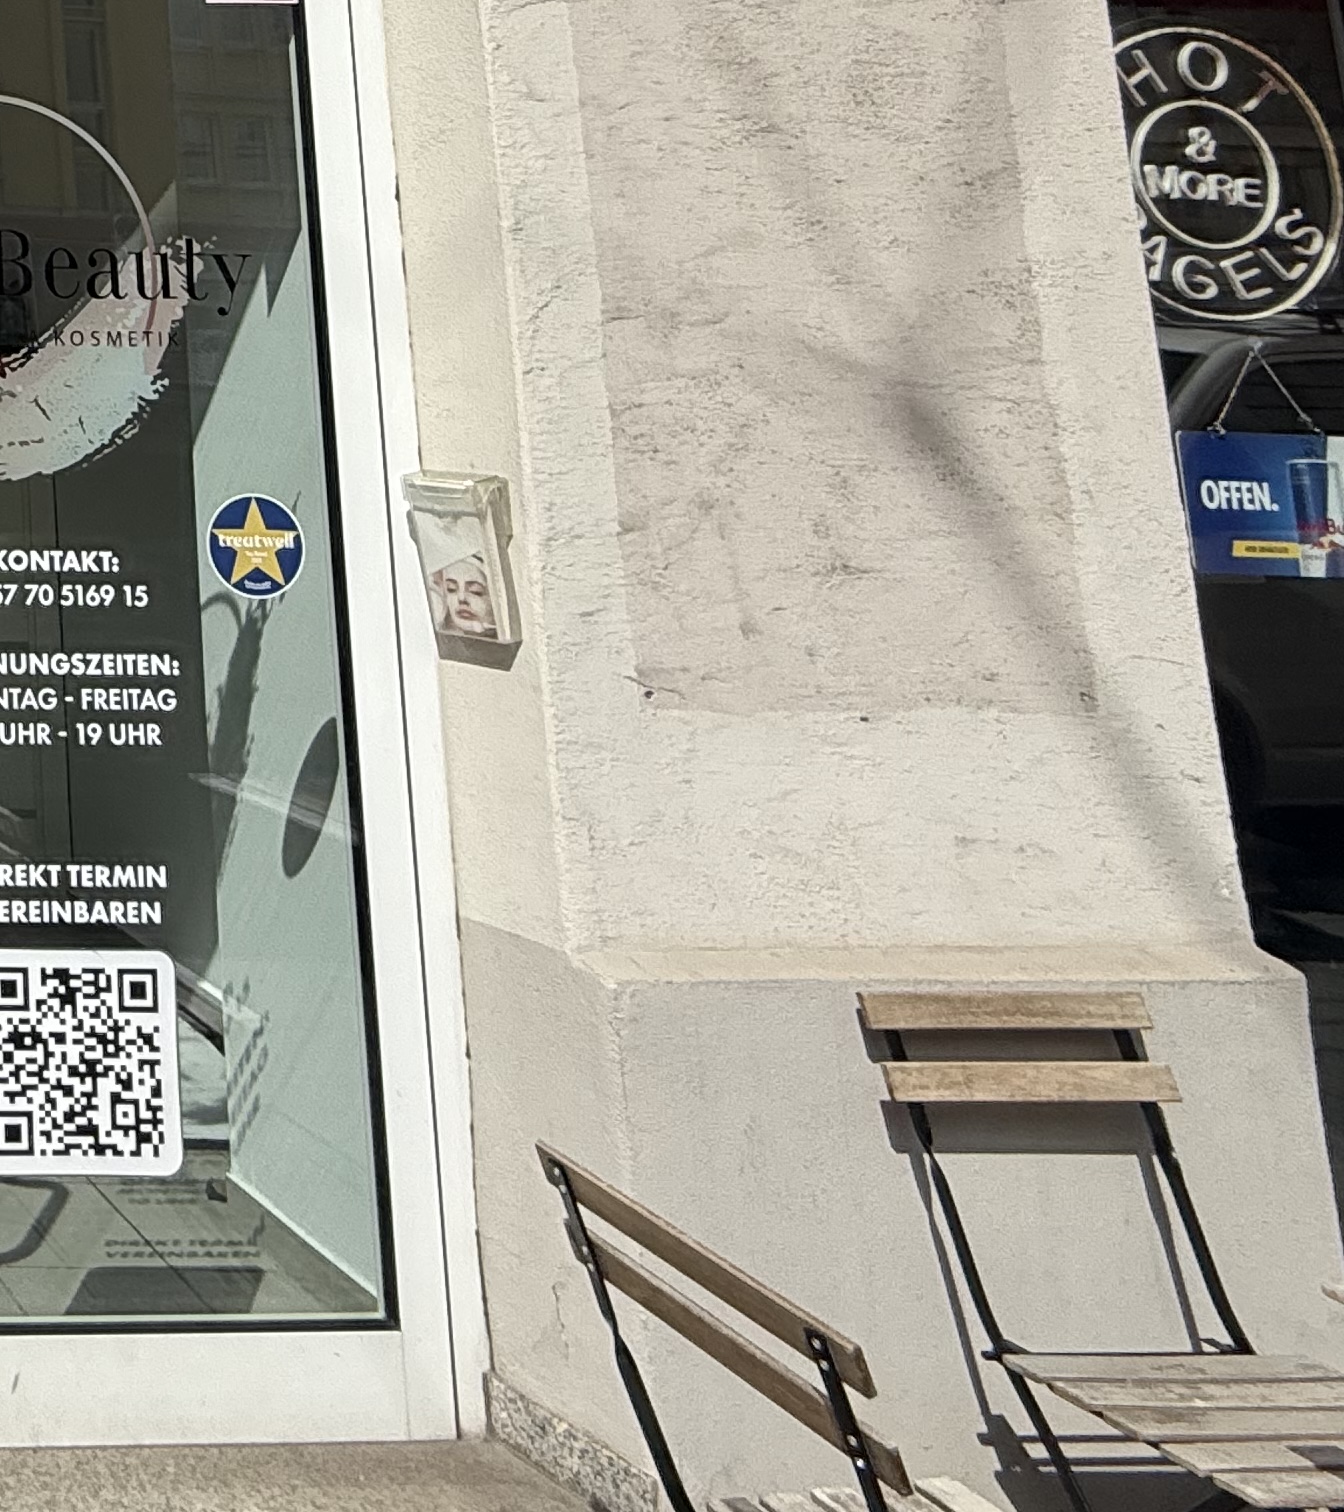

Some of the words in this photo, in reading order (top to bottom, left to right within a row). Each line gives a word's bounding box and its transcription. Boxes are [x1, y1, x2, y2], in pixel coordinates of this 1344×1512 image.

[1115, 40, 1289, 113] HOT
[1184, 125, 1217, 164] &
[1142, 164, 1264, 208] MORE
[1134, 201, 1325, 301] AGELS
[54, 329, 181, 348] KOSMETIK
[1200, 478, 1280, 513] OFFEN.
[218, 532, 295, 550] treatwell
[24, 584, 54, 608] 70
[60, 584, 115, 609] 5169
[122, 585, 149, 609] 15
[80, 687, 178, 712] FREITAG
[0, 722, 52, 746] UHR
[75, 723, 102, 746] 19
[109, 723, 162, 747] UHR
[67, 864, 168, 889] TERMIN
